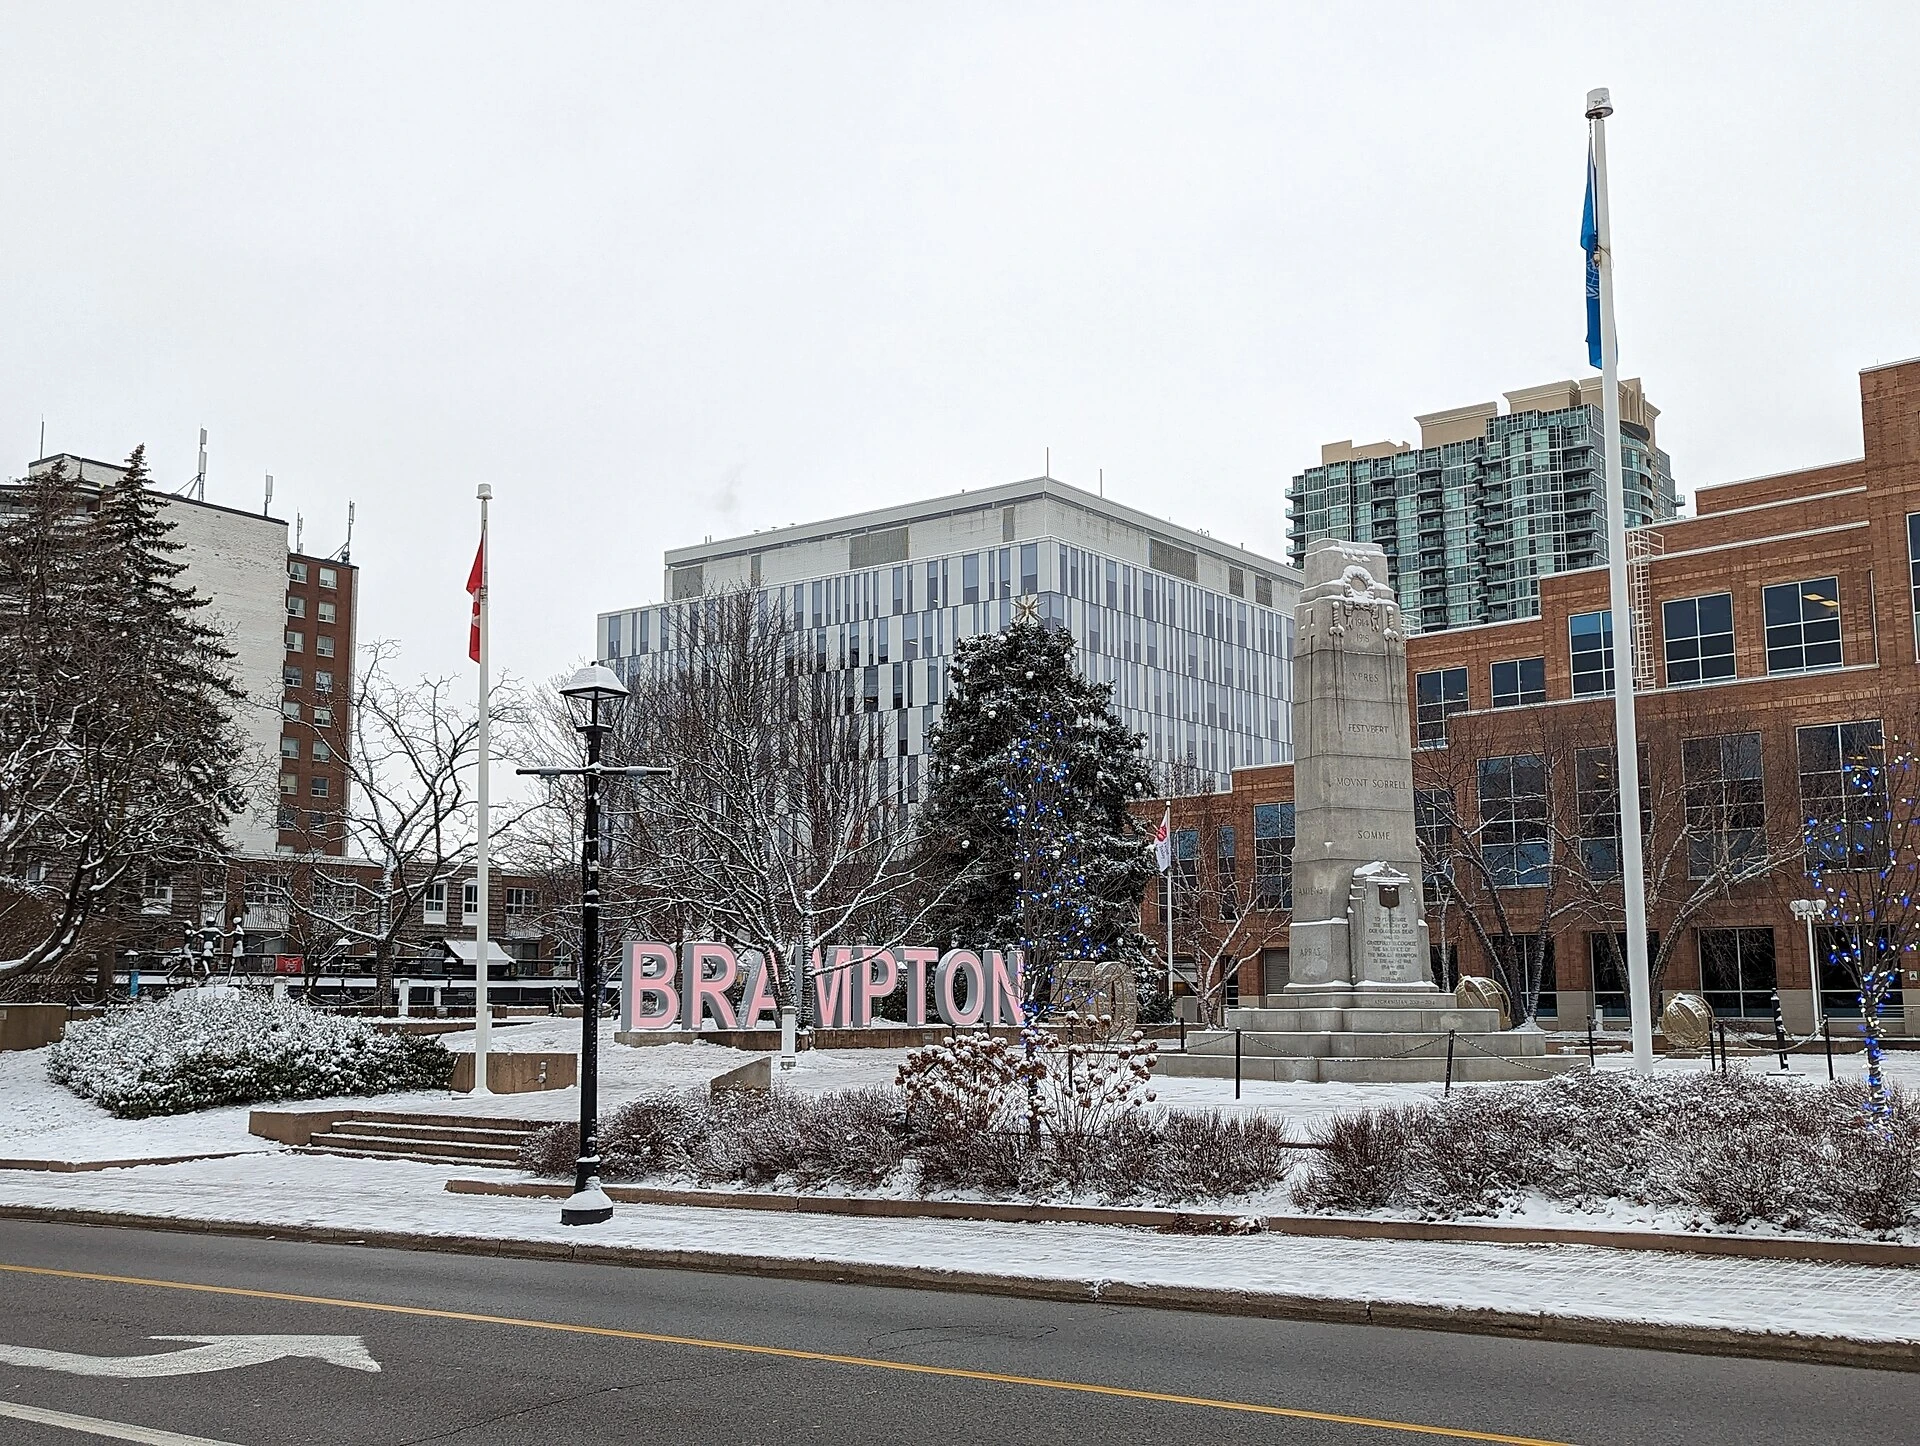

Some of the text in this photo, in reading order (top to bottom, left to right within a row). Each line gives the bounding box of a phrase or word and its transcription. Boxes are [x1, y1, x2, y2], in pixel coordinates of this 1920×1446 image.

[1352, 672, 1379, 683] YPRES
[1372, 779, 1408, 789] SORRELL
[1357, 830, 1391, 840] SOMME
[621, 941, 1025, 1032] BRAMPTON
